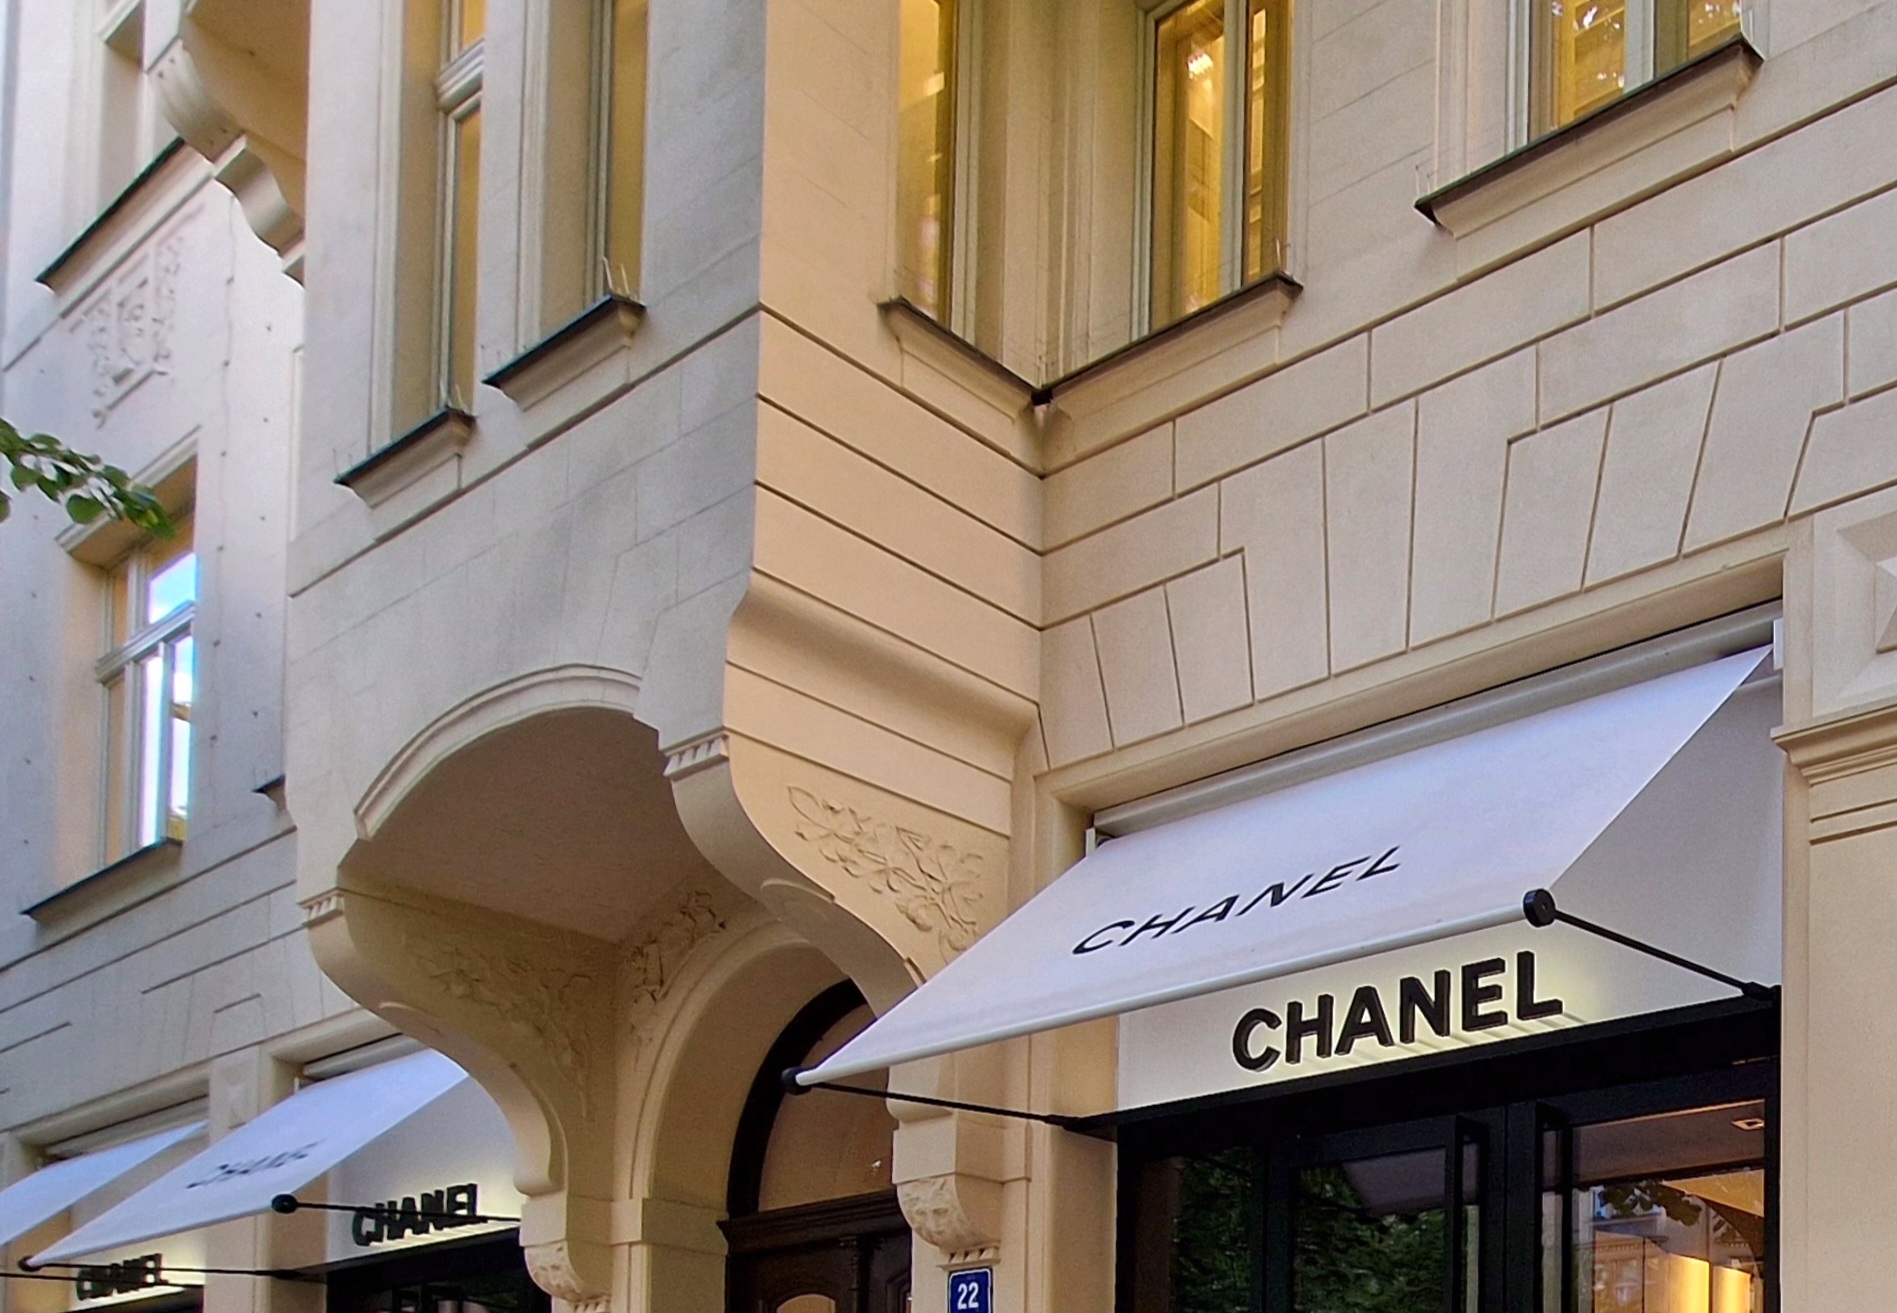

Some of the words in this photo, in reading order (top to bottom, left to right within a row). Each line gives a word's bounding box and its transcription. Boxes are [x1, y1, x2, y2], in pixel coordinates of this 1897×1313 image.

[1072, 845, 1401, 955] CHANEL
[1232, 950, 1563, 1071] CHANEL
[957, 1282, 979, 1310] 22
